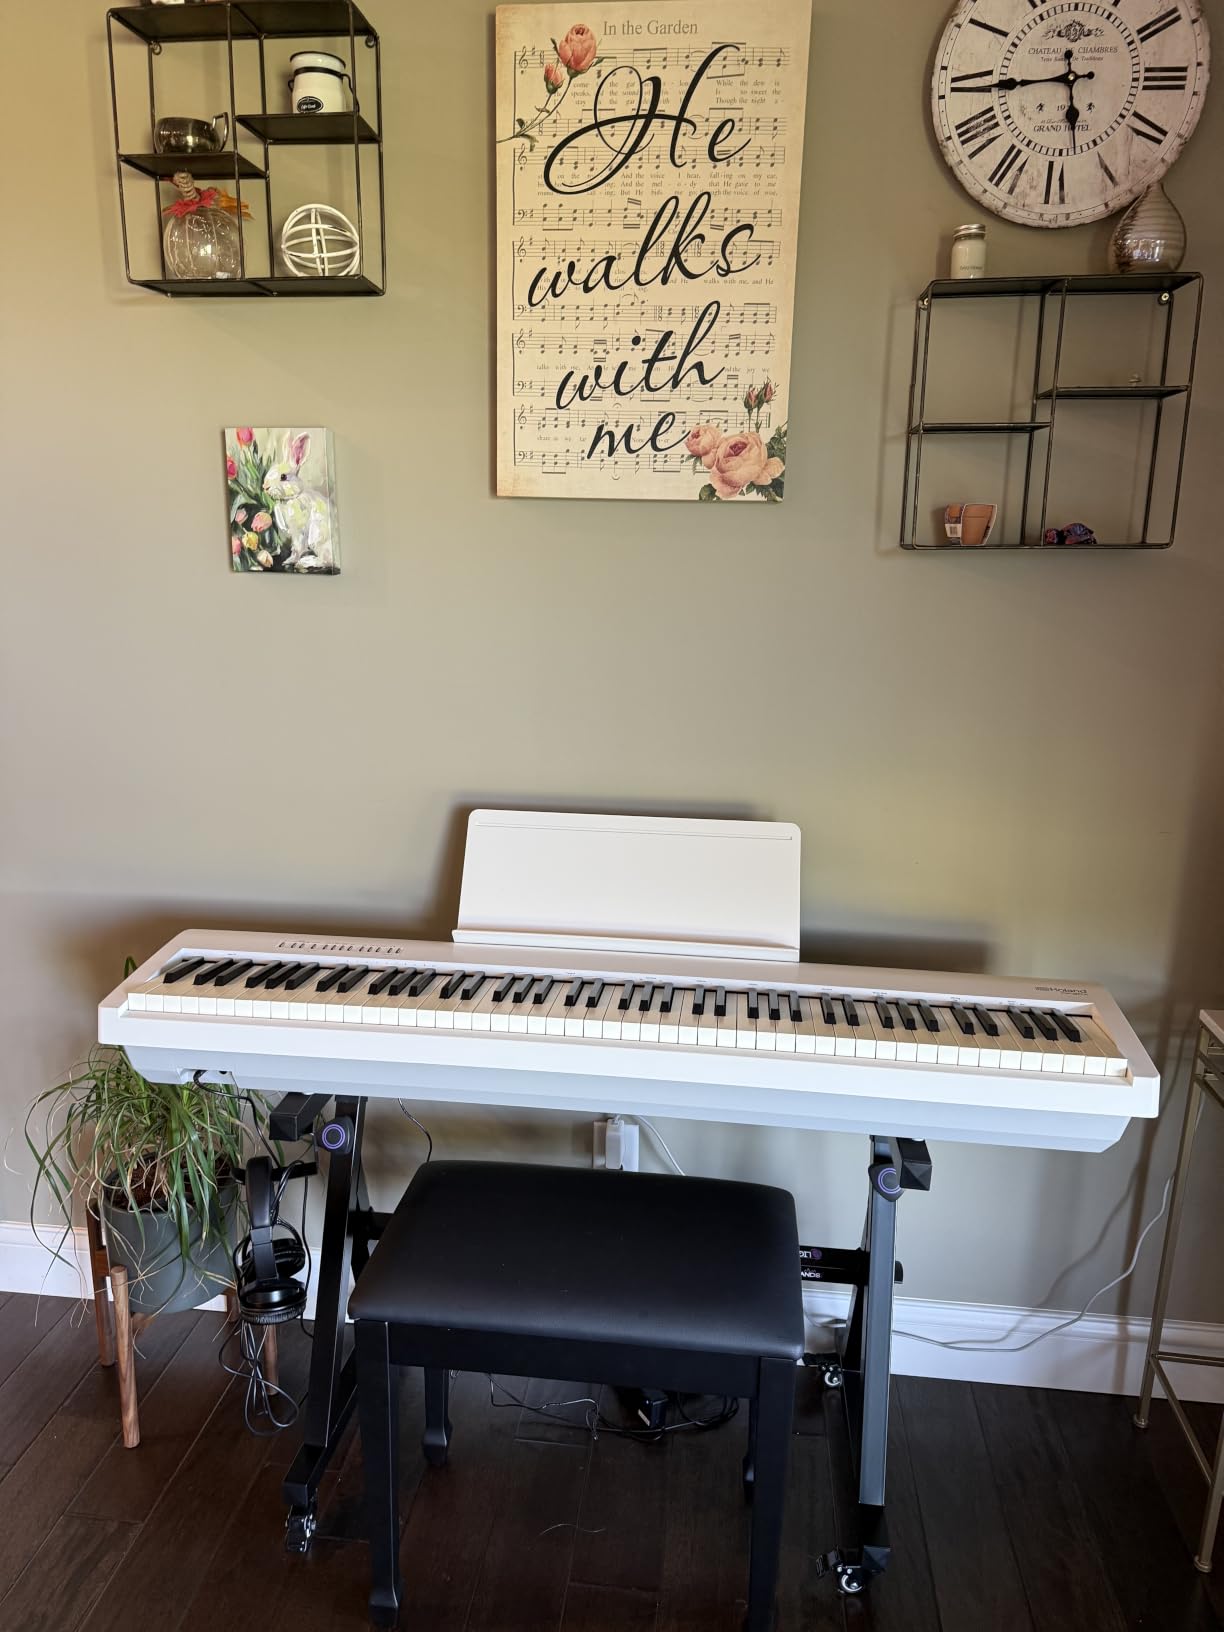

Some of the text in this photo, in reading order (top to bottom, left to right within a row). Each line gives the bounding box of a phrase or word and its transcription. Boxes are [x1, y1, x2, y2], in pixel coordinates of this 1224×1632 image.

[603, 19, 699, 36] In the Garden
[1028, 46, 1062, 56] CHATEAU
[1077, 45, 1119, 55] CHAMBRES
[715, 79, 734, 87] While
[715, 97, 737, 107] Though
[543, 43, 752, 195] He
[1033, 124, 1090, 133] GRAND HTEL
[620, 172, 633, 180] And
[635, 171, 645, 180] the
[620, 180, 633, 188] And
[635, 180, 645, 188] the
[723, 180, 732, 188] He
[527, 191, 761, 308] walks
[556, 300, 726, 410] with
[586, 411, 691, 460] me
